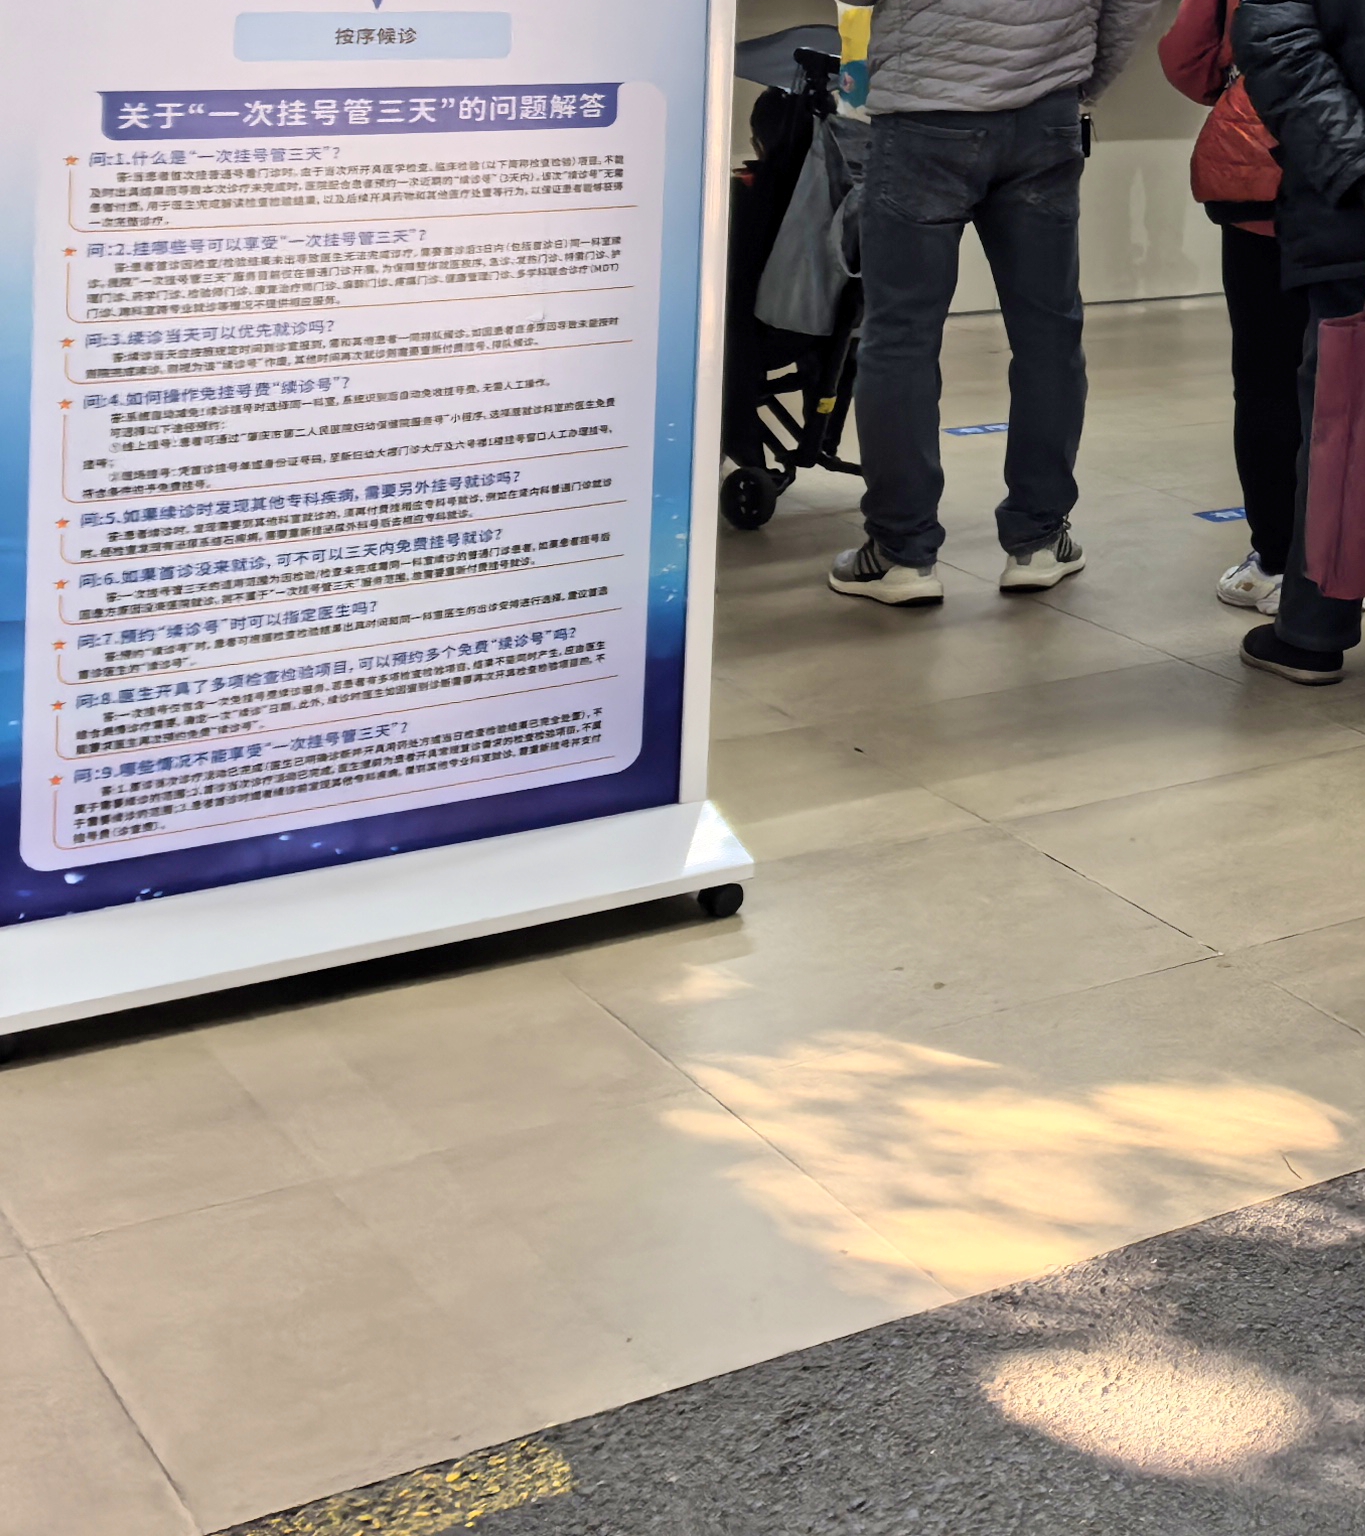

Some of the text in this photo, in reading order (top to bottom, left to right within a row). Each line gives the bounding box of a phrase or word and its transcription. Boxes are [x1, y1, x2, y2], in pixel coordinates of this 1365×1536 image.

[335, 28, 417, 46] 按序候诊
[117, 91, 607, 131] 关于“一次挂号管三天”的问题解答
